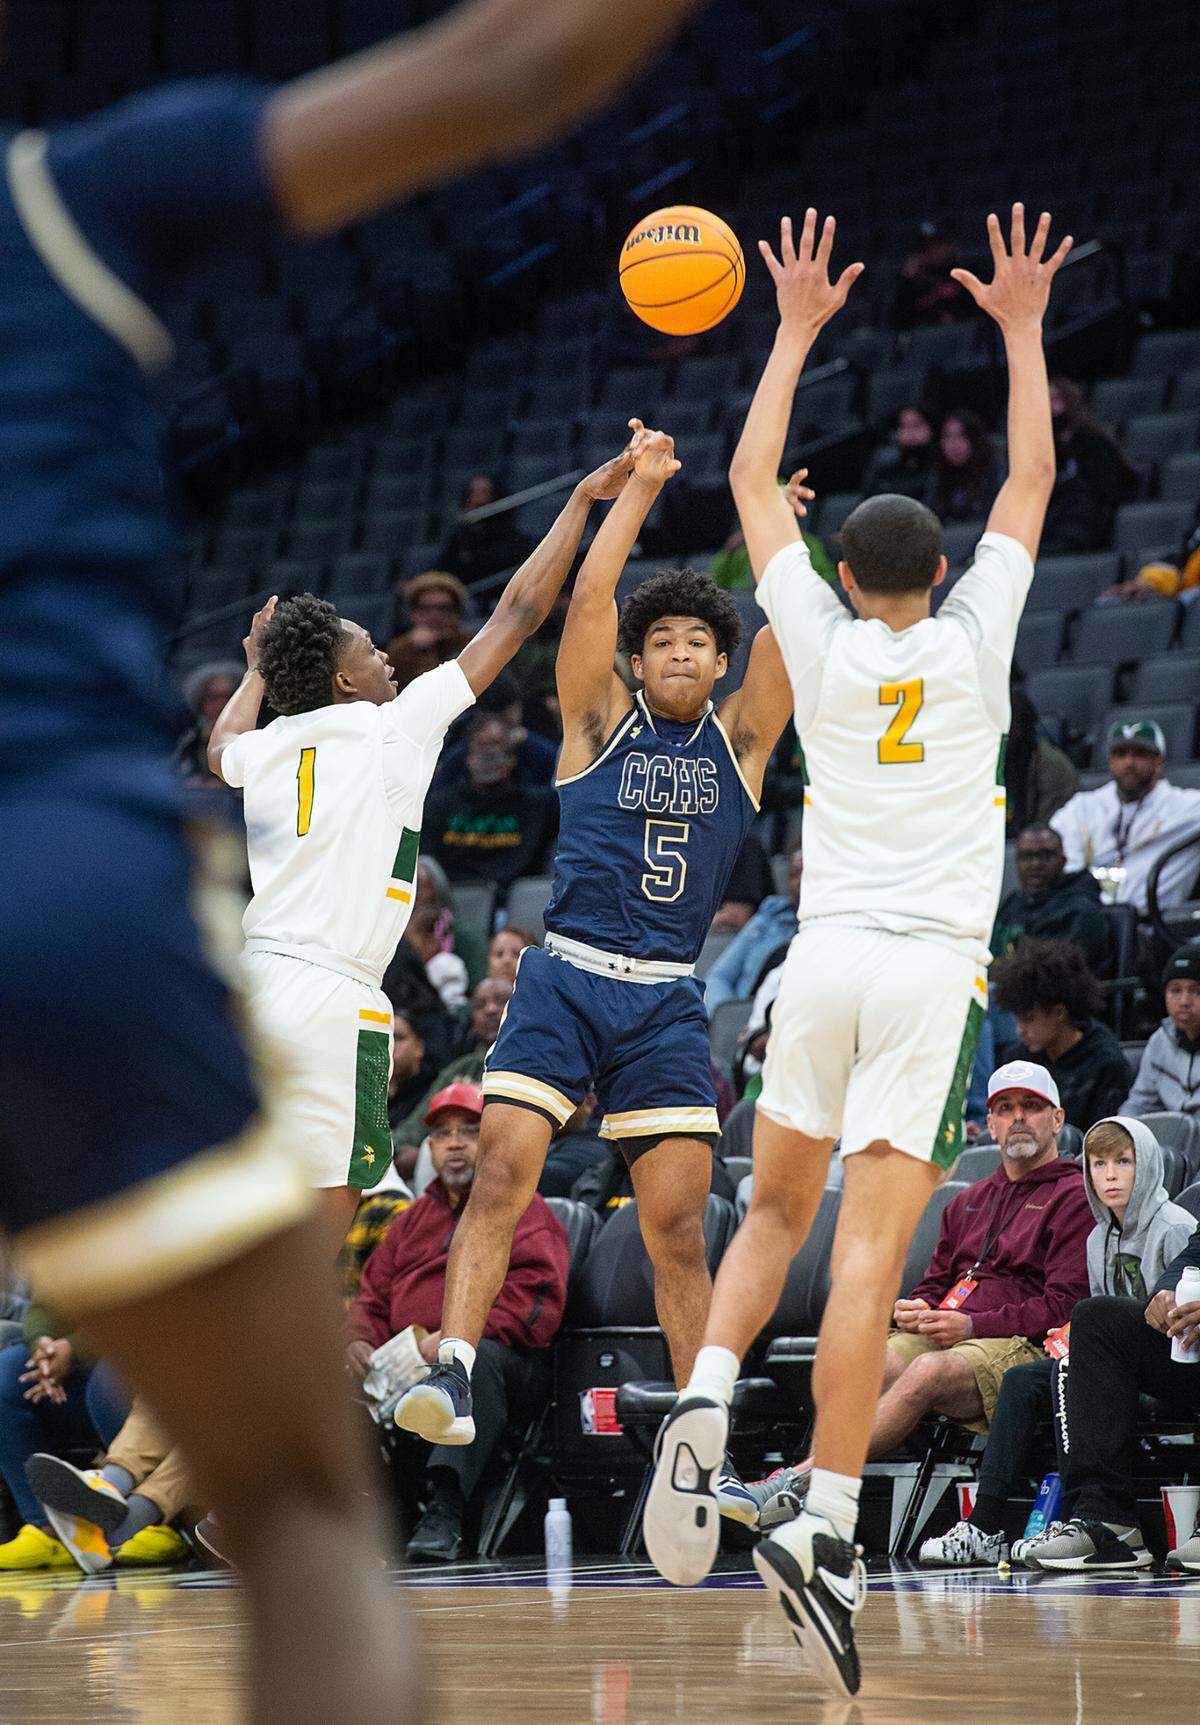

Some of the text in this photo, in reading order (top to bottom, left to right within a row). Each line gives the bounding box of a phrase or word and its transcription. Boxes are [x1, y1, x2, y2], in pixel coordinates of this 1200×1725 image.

[625, 224, 701, 251] Wilson
[877, 677, 924, 764] 2
[296, 747, 316, 837] 1
[617, 752, 719, 814] CCHS
[641, 819, 689, 902] 5
[1055, 1354, 1070, 1454] Champion
